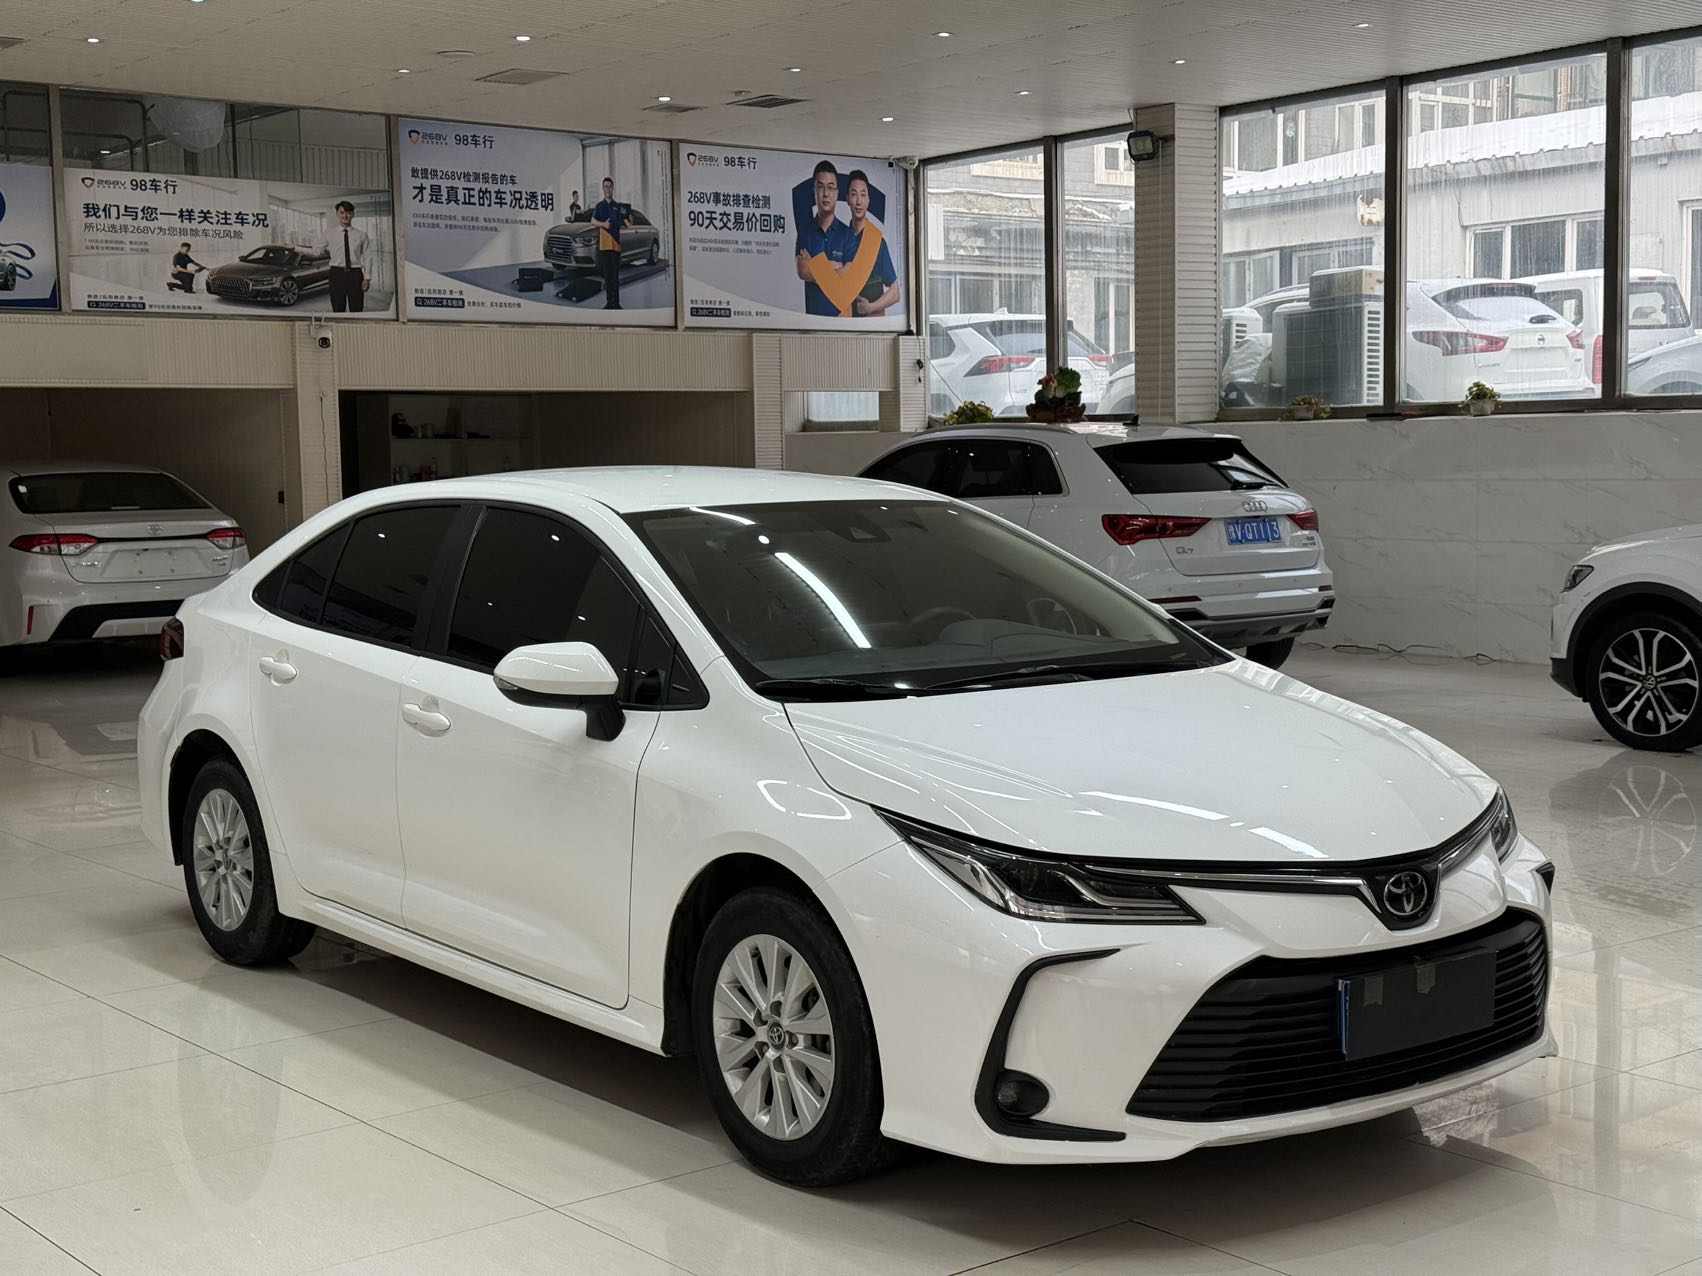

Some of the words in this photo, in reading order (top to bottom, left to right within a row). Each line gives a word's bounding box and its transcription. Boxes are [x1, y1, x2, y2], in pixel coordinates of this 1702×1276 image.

[421, 132, 448, 141] 268V
[454, 133, 495, 149] 98车行
[724, 156, 757, 170] 98车行
[411, 167, 518, 186] 敢提供268V检测报告的车
[130, 178, 178, 195] 98车行
[412, 183, 554, 212] 才是真正的车况透明
[687, 191, 771, 209] 268V事故排查检测
[83, 203, 270, 228] 我们与您一样关注车况
[688, 210, 786, 234] 90天交易价回购
[83, 222, 244, 240] 所以选择268V为您排除车况风险
